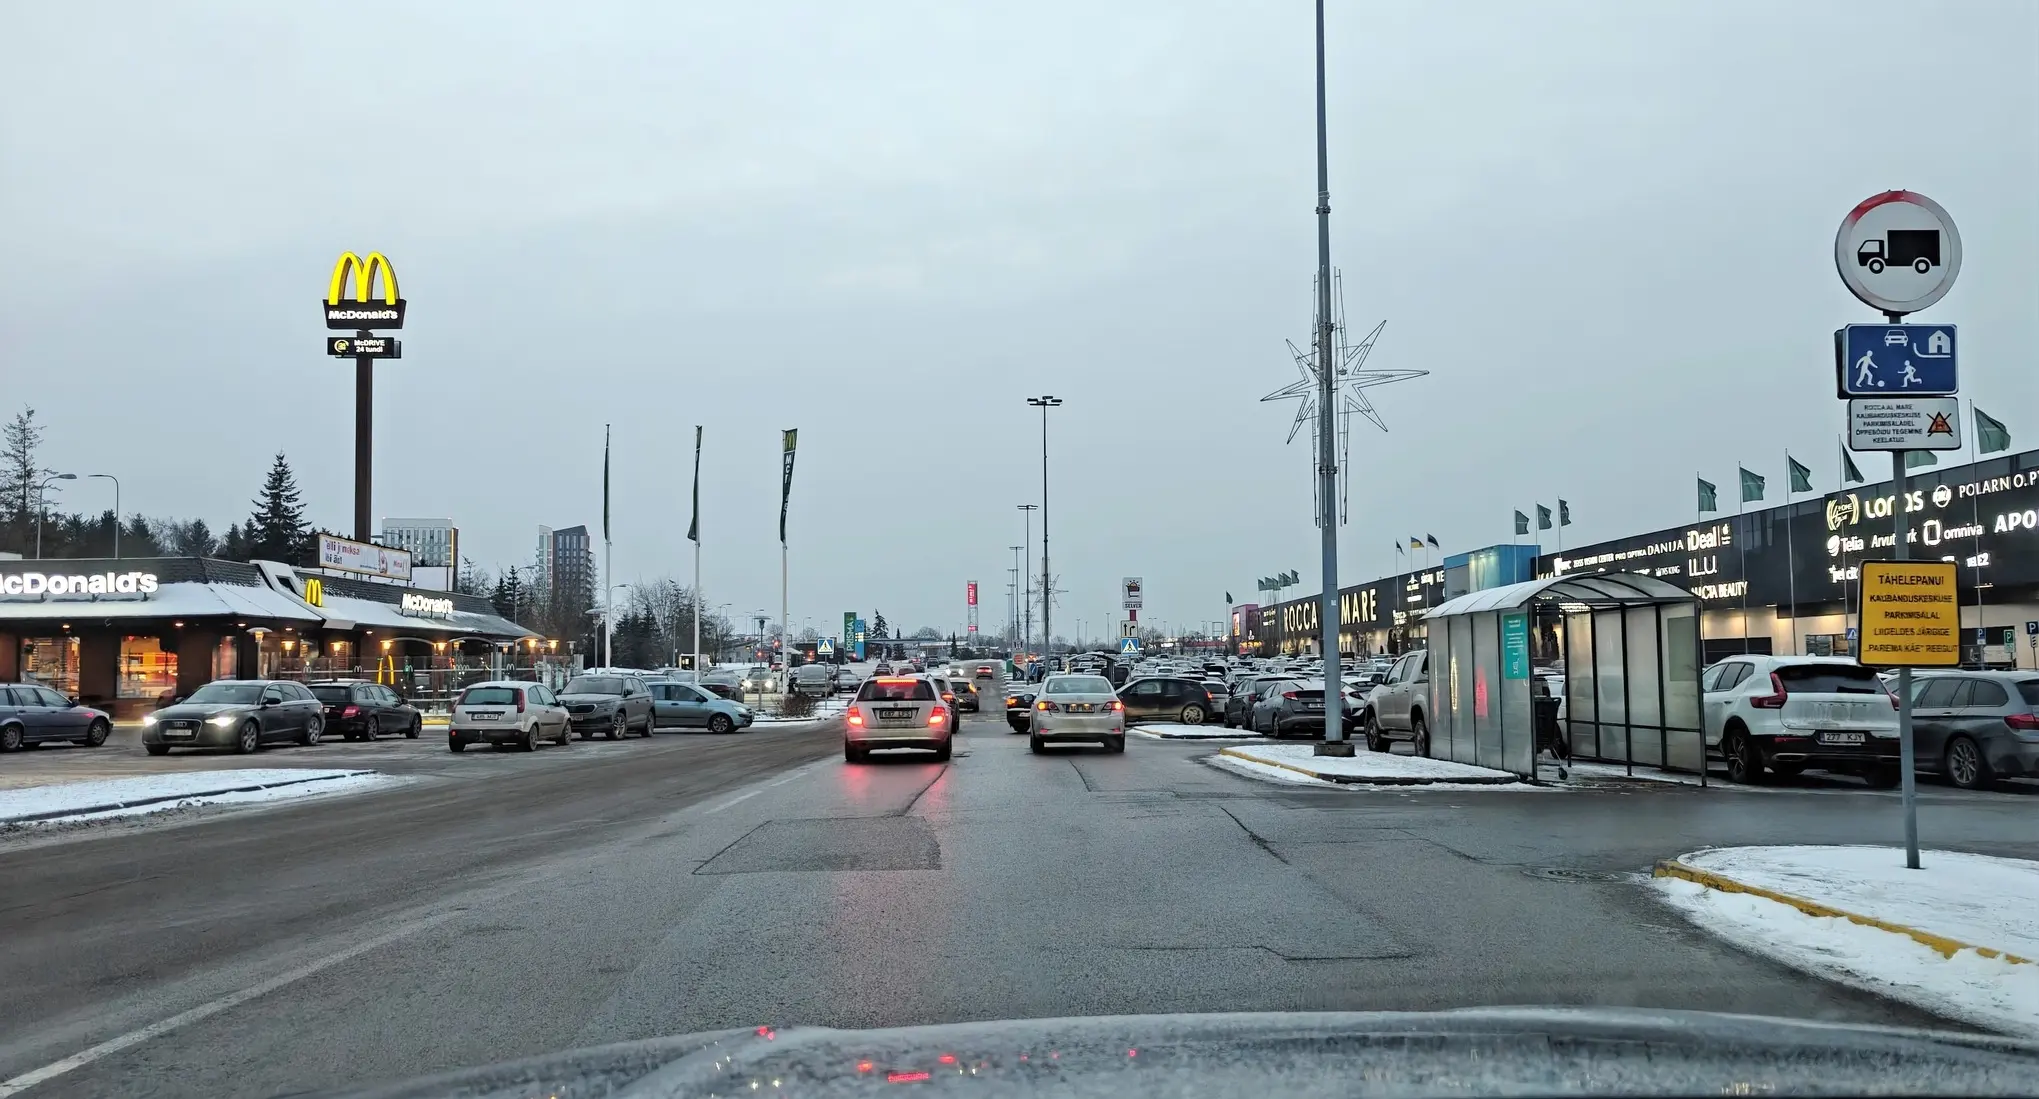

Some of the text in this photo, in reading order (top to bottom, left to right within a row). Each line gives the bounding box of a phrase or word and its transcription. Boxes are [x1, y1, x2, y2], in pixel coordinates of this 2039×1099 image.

[328, 310, 398, 319] McDonald's
[1959, 476, 2010, 498] POLARN
[2029, 470, 2039, 486] P
[1994, 510, 2039, 533] APO
[1687, 526, 1717, 551] iDeal
[1943, 523, 1983, 540] omniva
[1647, 539, 1684, 556] DANIJA
[1840, 535, 1864, 553] Telia
[1598, 553, 1614, 563] CENTER
[1615, 552, 1626, 561] PRO
[1966, 552, 1990, 568] TELE2
[1878, 573, 1944, 586] TÄHELEPANU!
[1718, 581, 1748, 598] BEAUTY
[402, 593, 453, 614] McDonald's
[1341, 588, 1377, 625] MARE
[1869, 594, 1953, 603] KAUBANDUSKESKUSE
[1283, 601, 1318, 632] ROCCA
[1884, 611, 1940, 619] PARKIMISALAL
[1873, 627, 1915, 636] LIIGELDES
[1978, 628, 1984, 638] P
[2028, 622, 2037, 633] P
[846, 621, 854, 651] PRISMA
[2006, 632, 2012, 642] P
[1826, 733, 1863, 741] 277 KJY
